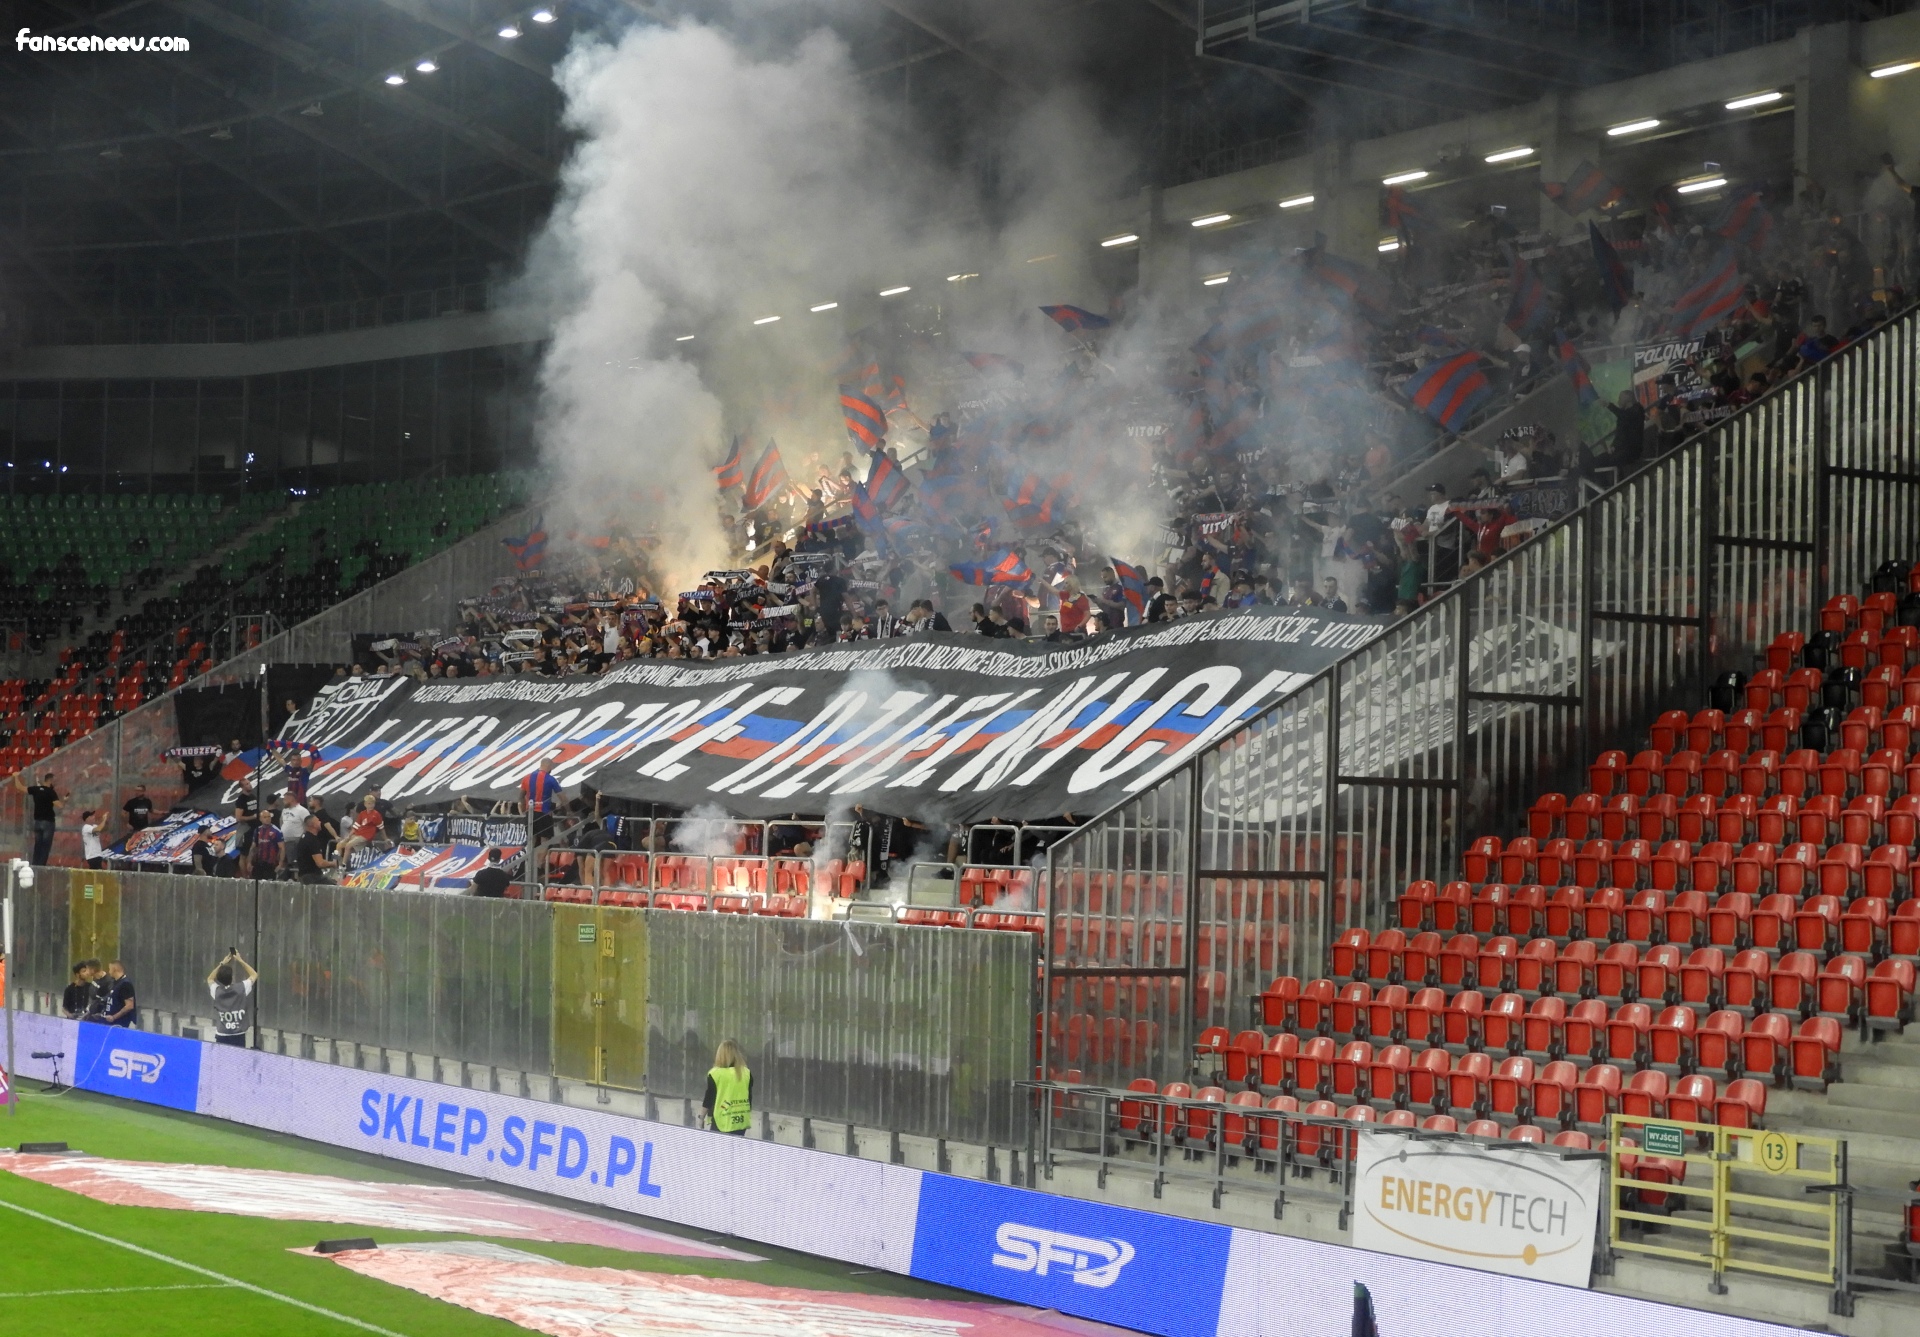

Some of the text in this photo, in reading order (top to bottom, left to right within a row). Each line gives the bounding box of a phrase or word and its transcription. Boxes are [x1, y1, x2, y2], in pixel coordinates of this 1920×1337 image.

[451, 818, 484, 838] WOJTEK
[604, 936, 612, 950] 12
[108, 1048, 166, 1085] SFD
[358, 1088, 662, 1199] SKLEP.SFD.PL
[1648, 1131, 1679, 1143] WYJŚCIE
[1766, 1142, 1784, 1161] 13
[1379, 1174, 1568, 1237] ENERGYTECH
[991, 1222, 1136, 1289] SFD
